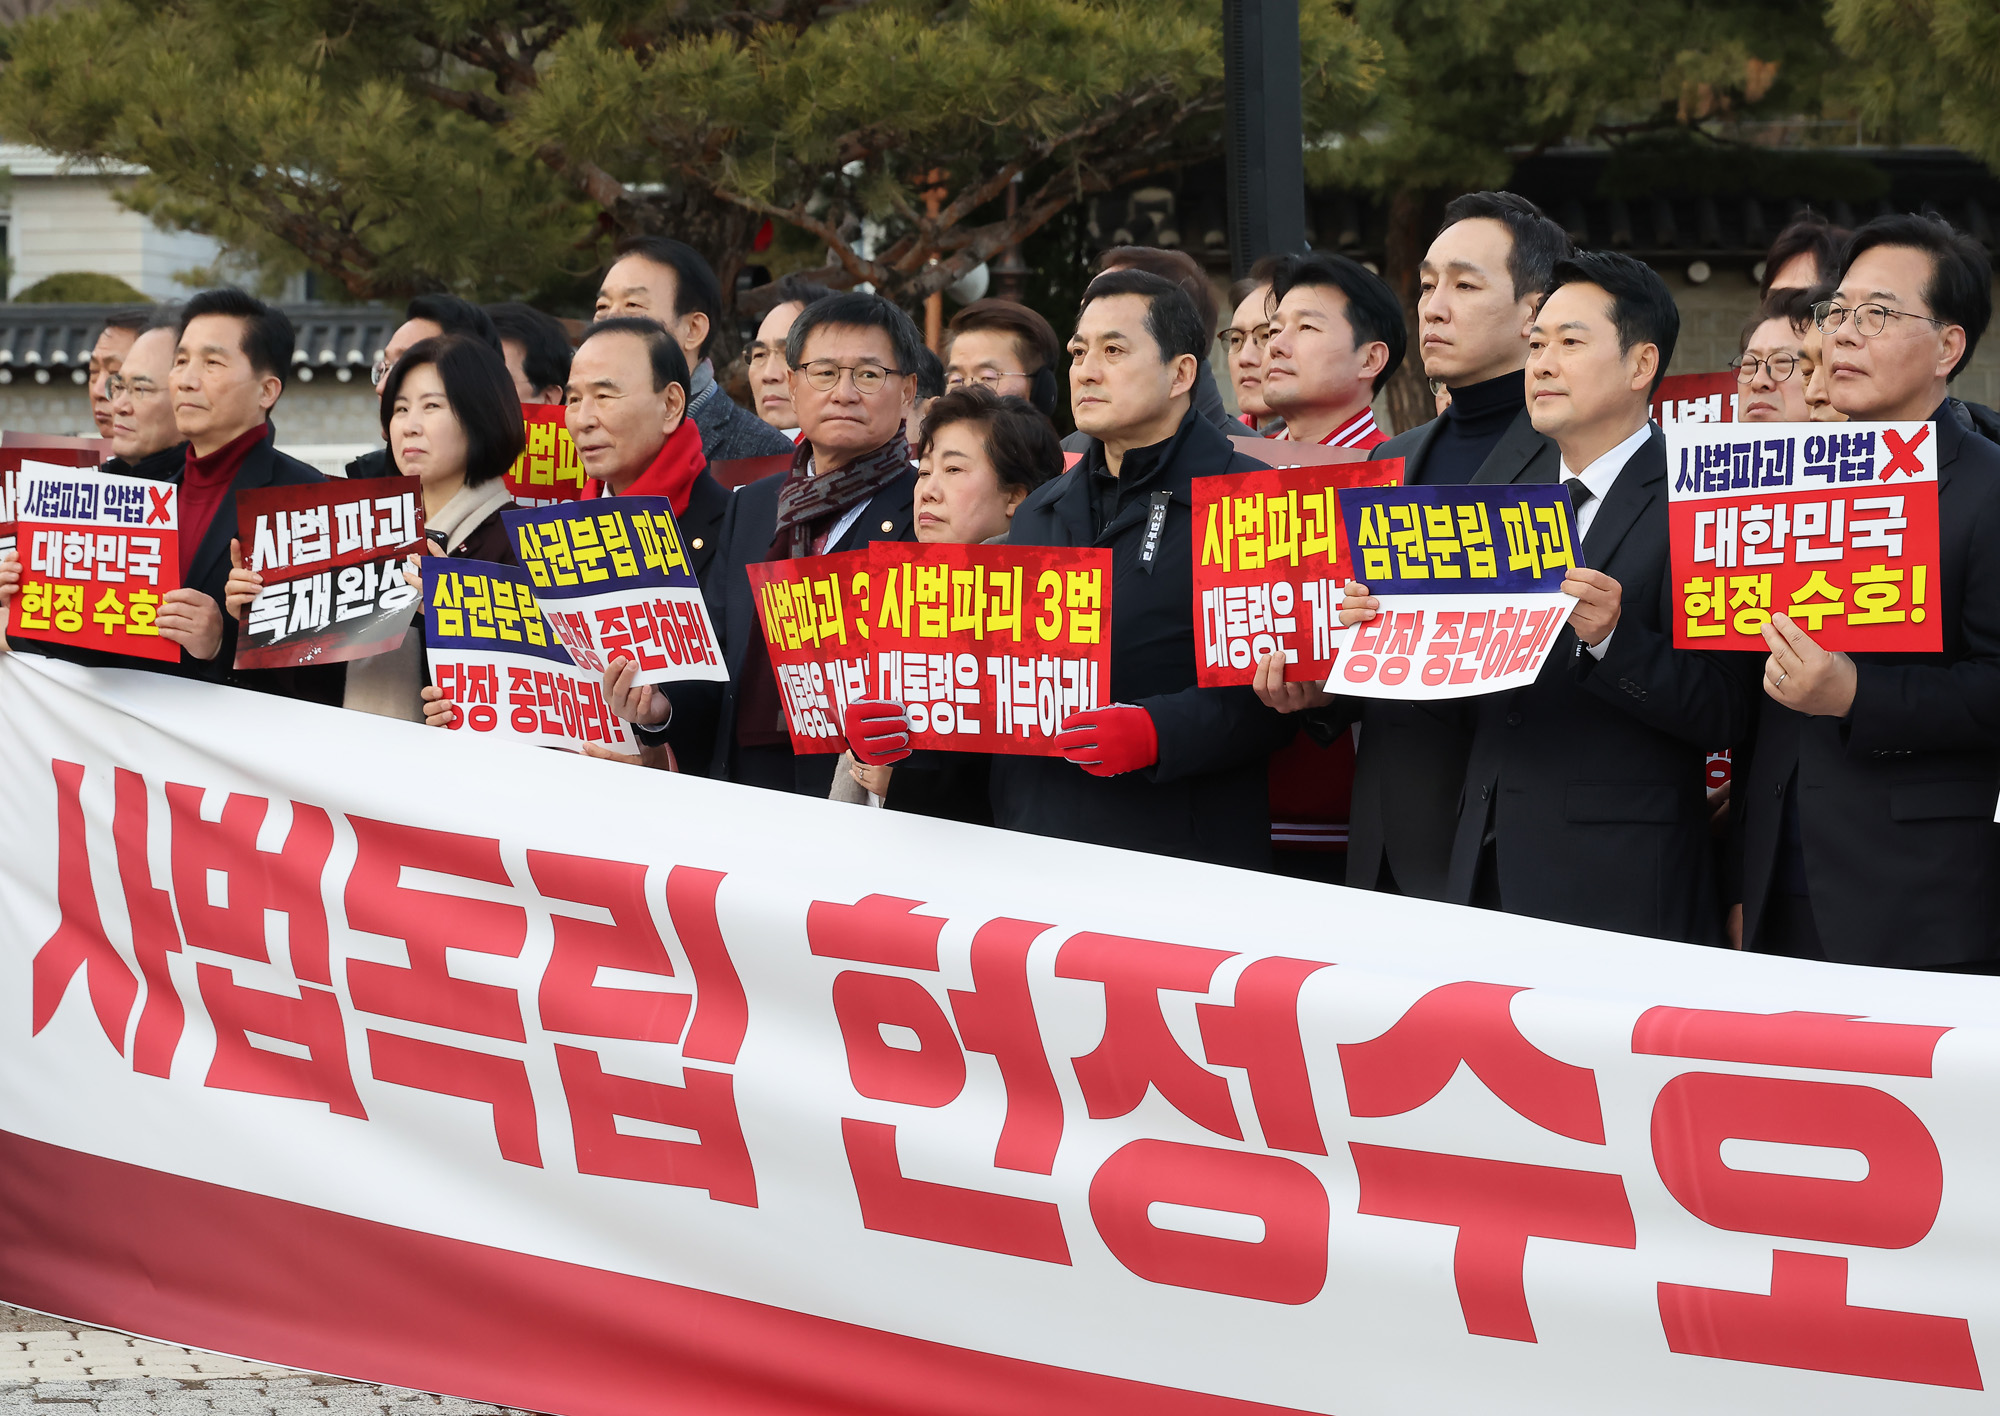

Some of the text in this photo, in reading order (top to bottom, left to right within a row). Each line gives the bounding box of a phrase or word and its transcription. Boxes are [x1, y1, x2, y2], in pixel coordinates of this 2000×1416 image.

[1675, 431, 1876, 493] 사법파괴 악법
[24, 480, 100, 520] 사법파괴
[103, 484, 145, 524] 악법
[1200, 486, 1338, 573] 사법파괴
[1357, 501, 1578, 580] 삼권분립 파괴
[1693, 495, 1908, 569] 대한민국
[31, 530, 162, 586] 대한민국
[517, 509, 691, 588] 삼권분립 파괴
[20, 580, 167, 637] 헌정 수호
[432, 572, 548, 648] 삼권분립
[546, 598, 719, 674] 당장 중단하라!
[761, 572, 848, 651] 사법파괴
[878, 562, 1102, 645] 사법파괴 3법
[1202, 581, 1299, 669] 대통령은
[1684, 563, 1928, 638] 헌정 수호!
[1344, 606, 1566, 687] 당장 중단하라!
[436, 662, 626, 744] 당장 중단하라!
[776, 661, 839, 739] 대통령은
[878, 650, 981, 736] 대통령은
[32, 757, 760, 1210] 사법독립
